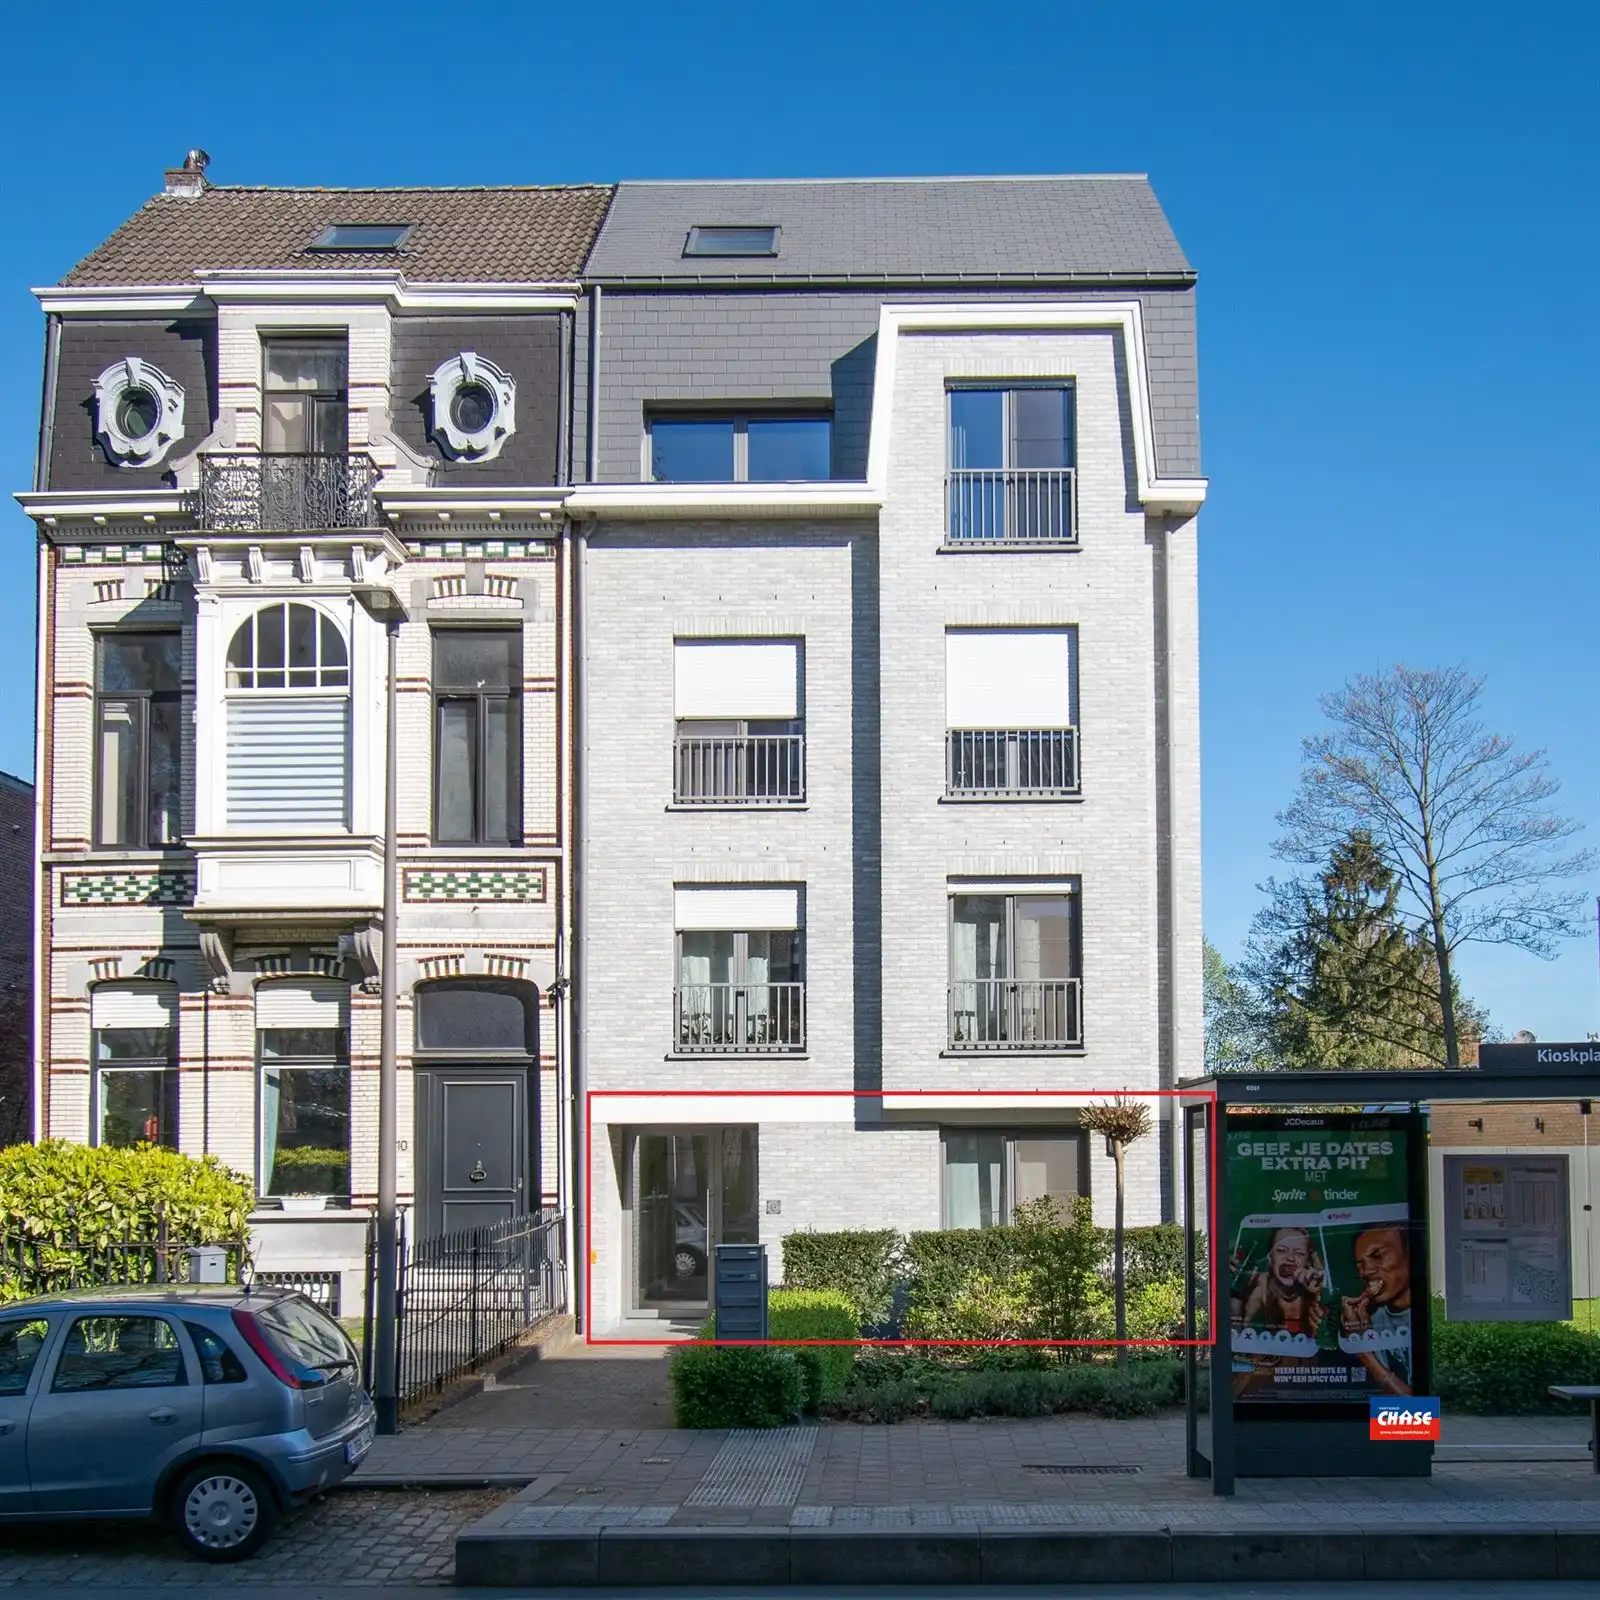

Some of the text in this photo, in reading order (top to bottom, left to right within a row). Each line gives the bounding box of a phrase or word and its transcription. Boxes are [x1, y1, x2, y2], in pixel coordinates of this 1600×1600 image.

[1284, 1118, 1325, 1126] JCDecaux
[1236, 1141, 1394, 1156] GEEF JE DATES
[1261, 1156, 1370, 1170] EXTRA PIT
[1304, 1170, 1328, 1183] MET
[1271, 1188, 1359, 1203] Sprite tinder
[1311, 1366, 1336, 1375] SPRITE
[1307, 1375, 1329, 1383] SPICY
[1329, 1375, 1348, 1383] DATE
